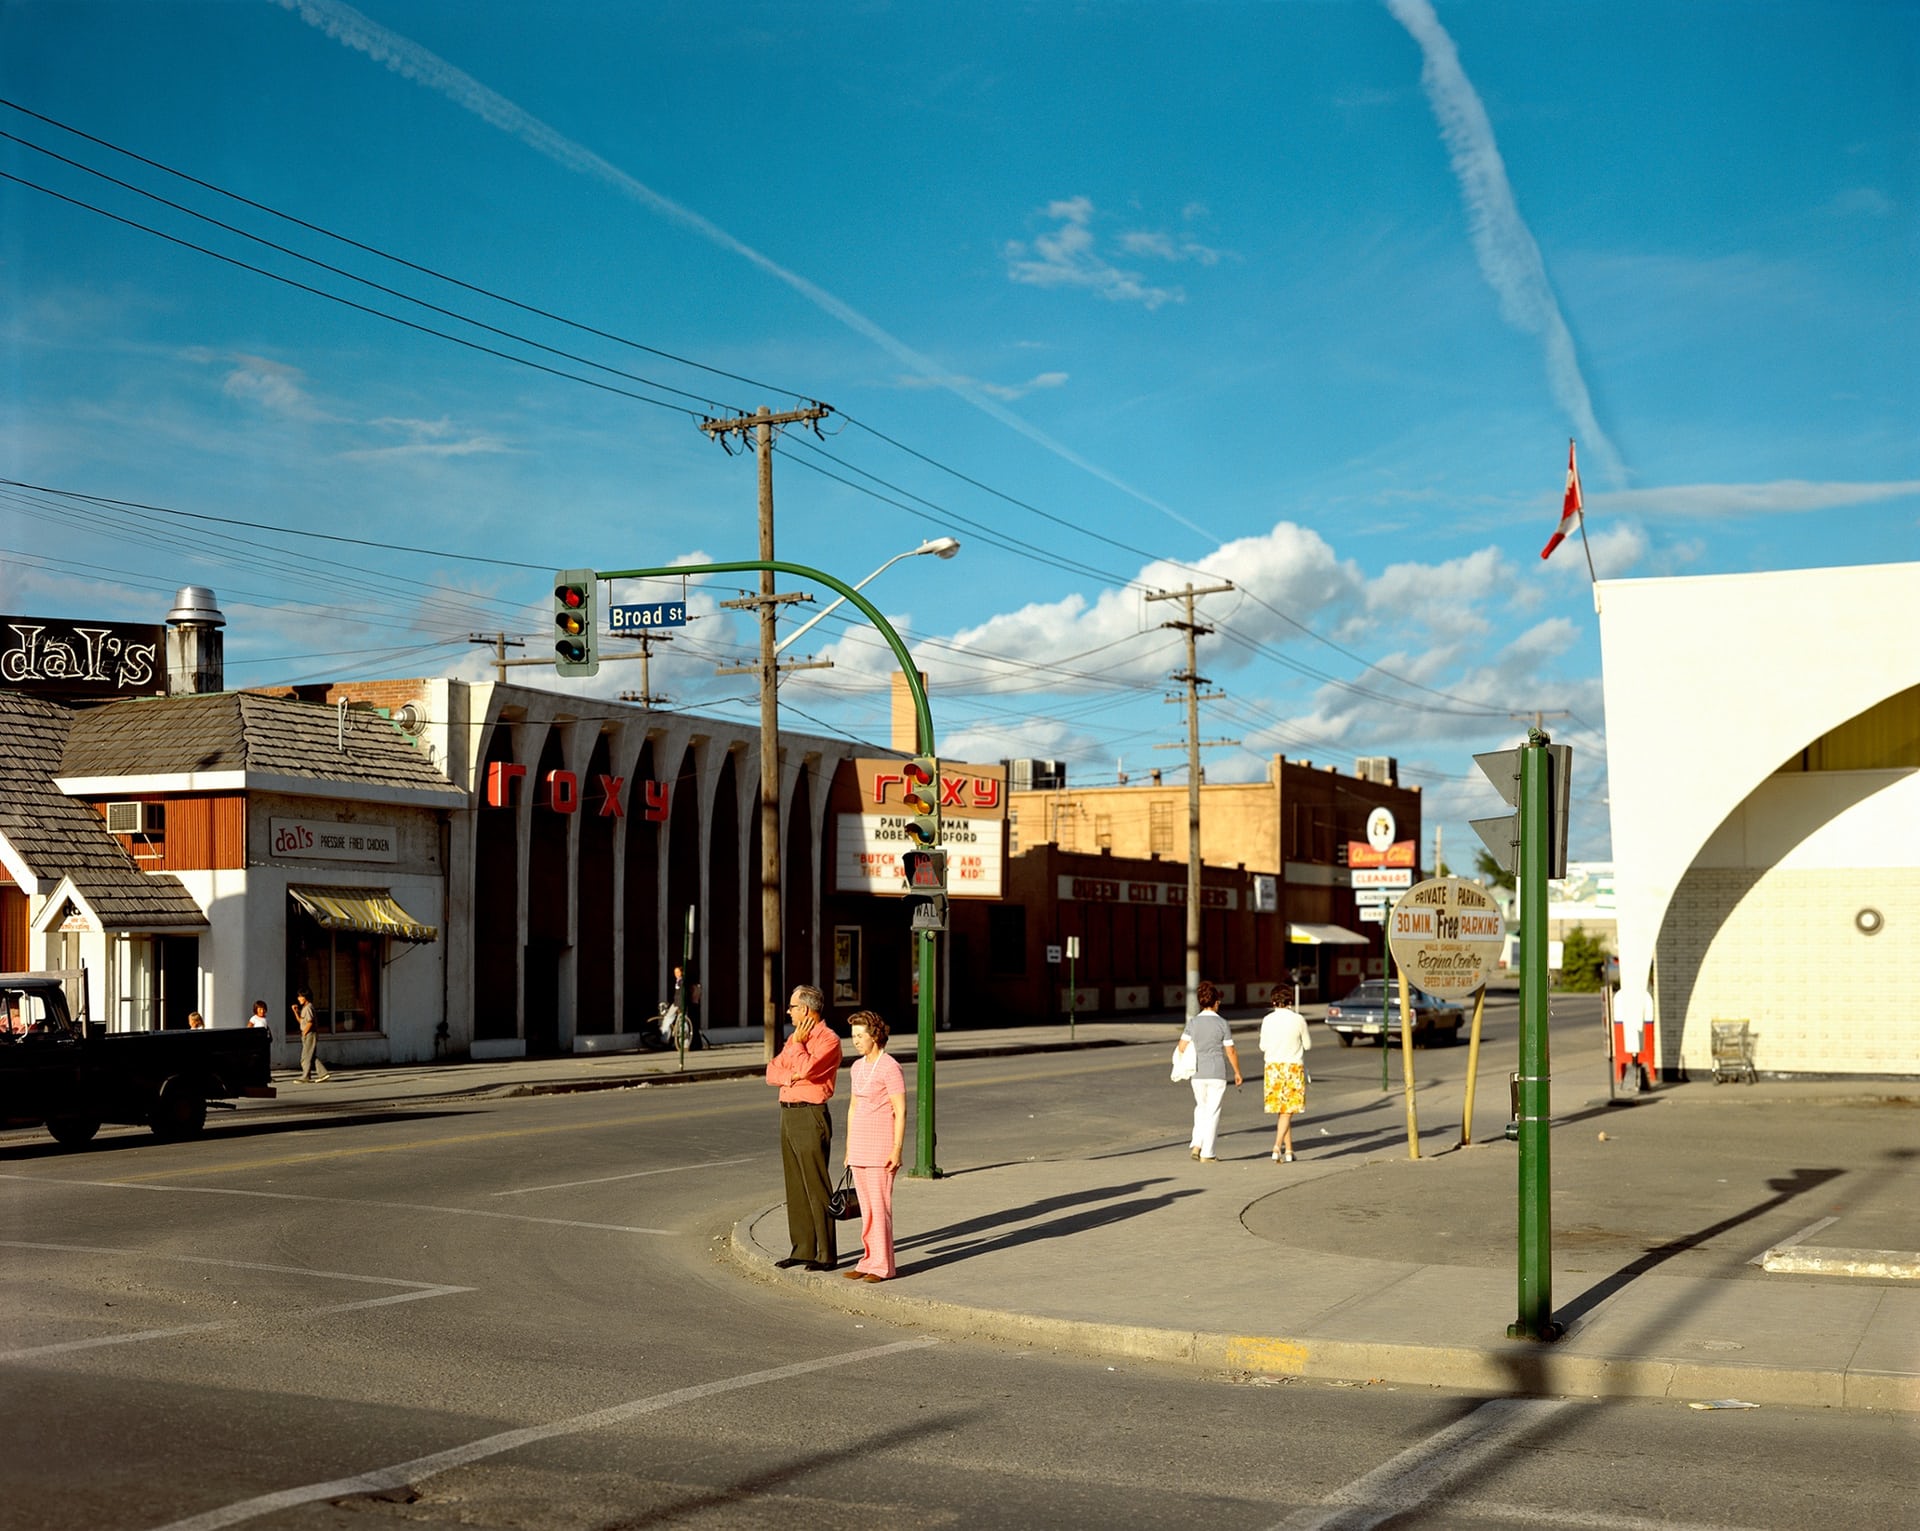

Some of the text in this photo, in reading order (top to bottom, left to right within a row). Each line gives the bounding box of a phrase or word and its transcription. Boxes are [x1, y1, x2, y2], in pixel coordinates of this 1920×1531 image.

[613, 606, 682, 627] Broad St
[1, 623, 156, 689] dal's
[488, 761, 669, 822] roxy
[275, 825, 389, 852] dal's PRESSURE FRIED CHICKEN
[875, 829, 977, 843] ROBER DFORD
[961, 856, 981, 866] AND
[862, 866, 881, 877] THE
[915, 871, 938, 885] WAL
[1355, 874, 1408, 883] CLEANERS
[1128, 883, 1157, 902] CITY
[1415, 886, 1486, 907] PRIVATE PARKING
[915, 903, 938, 918] WAL
[1397, 908, 1499, 939] 30 MIN. Free PARKING
[1417, 950, 1452, 972] Regina
